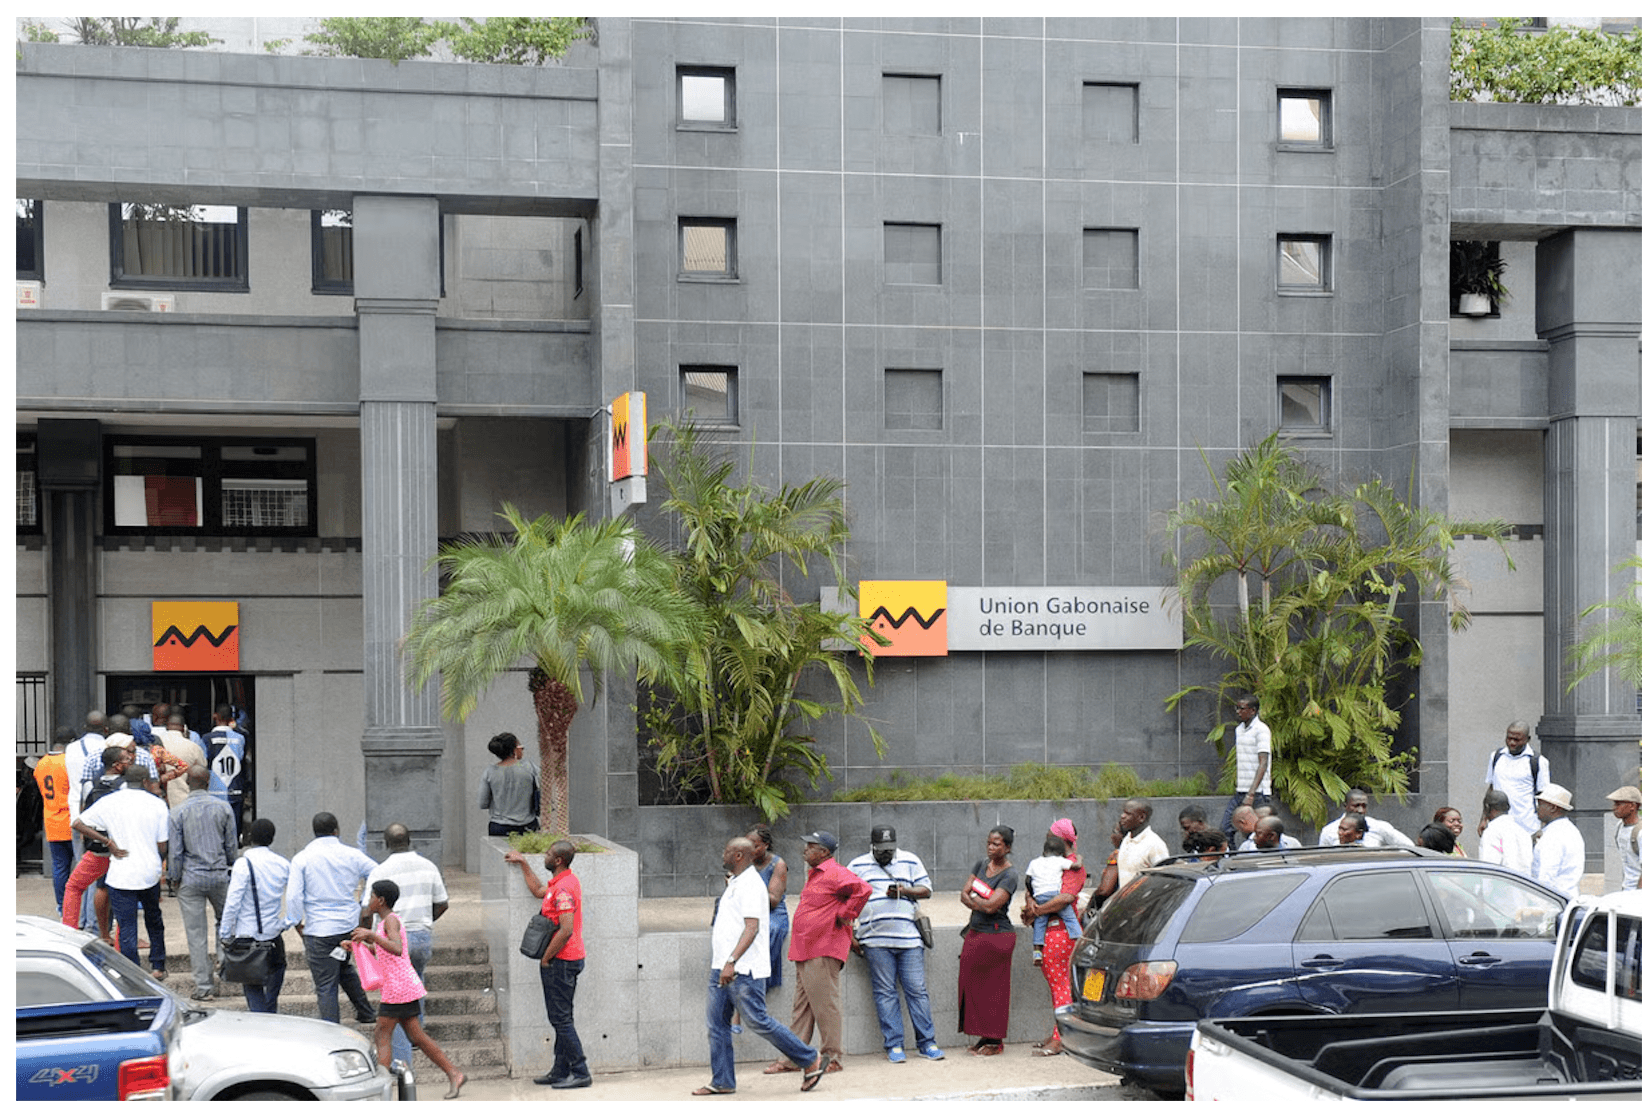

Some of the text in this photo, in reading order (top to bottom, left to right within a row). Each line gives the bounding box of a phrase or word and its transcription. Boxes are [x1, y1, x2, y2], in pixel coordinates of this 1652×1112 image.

[980, 597, 1150, 614] Union Gabonaise
[979, 619, 1087, 640] de Banque
[218, 756, 235, 776] 10
[43, 775, 55, 800] 9
